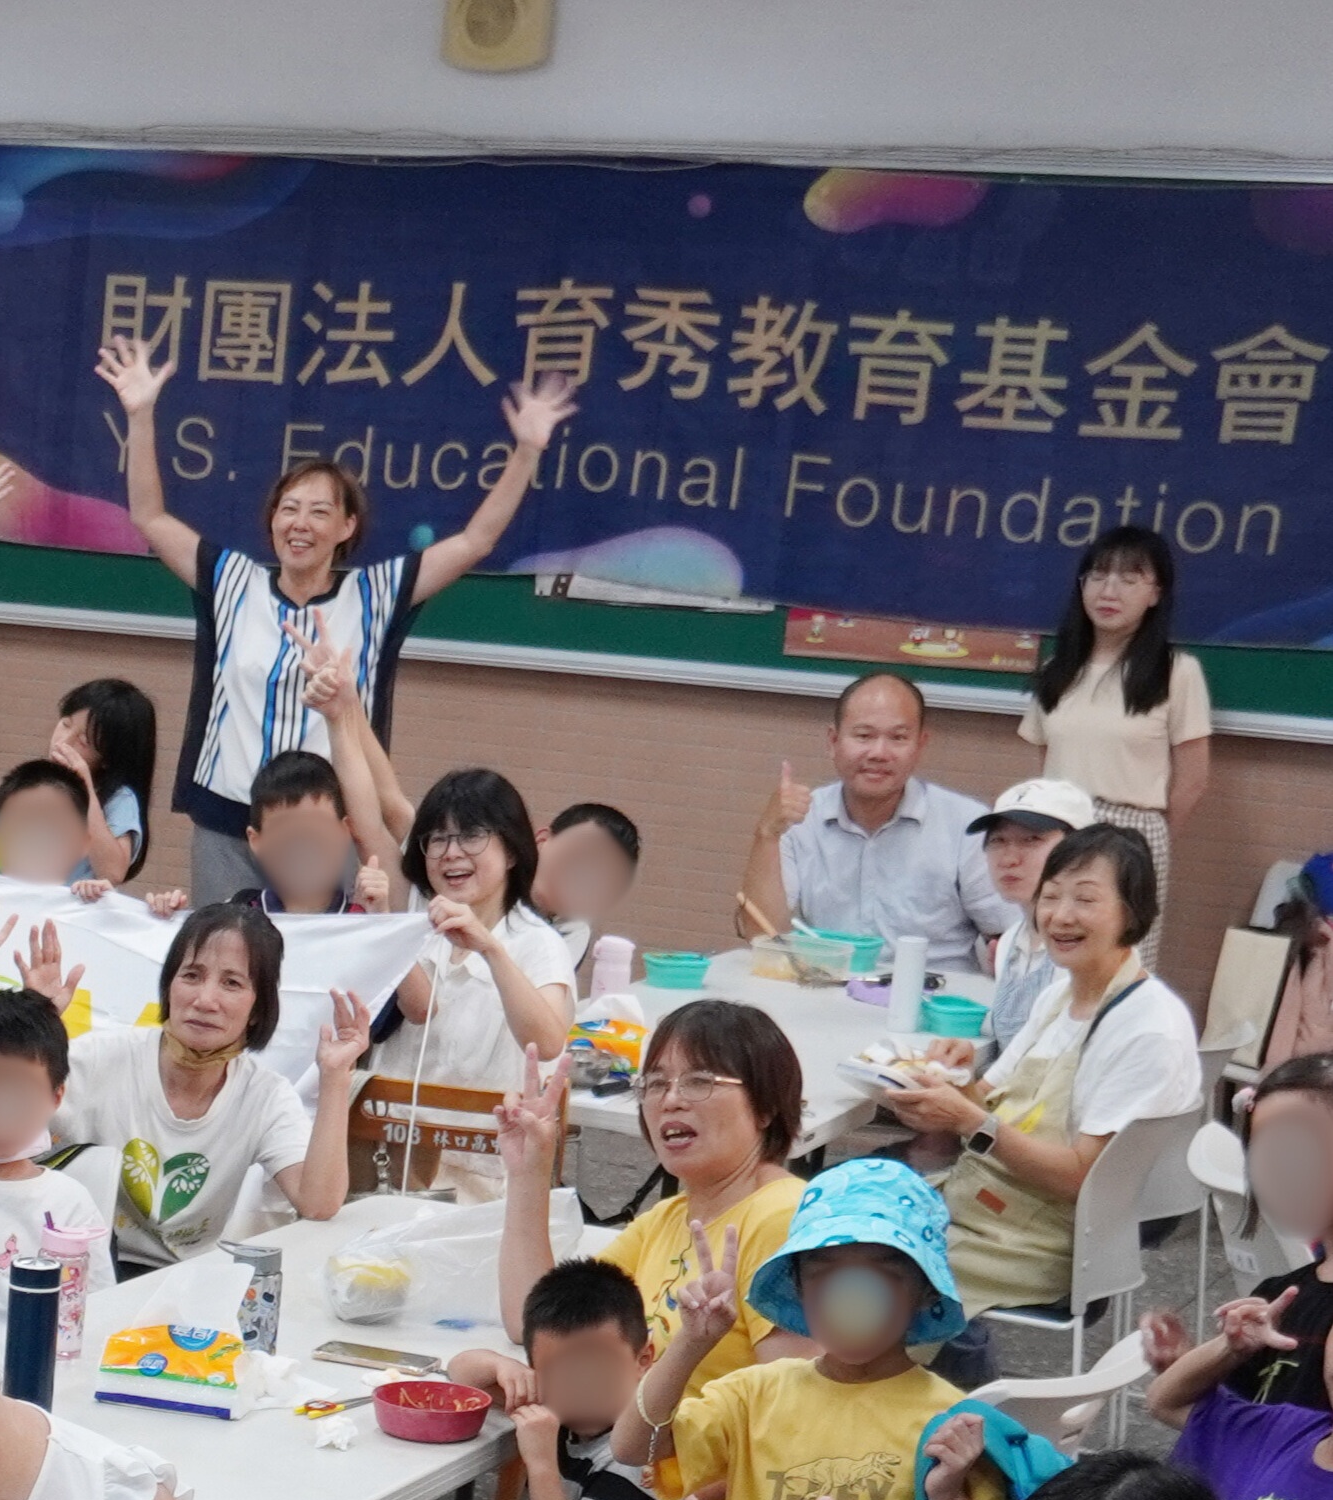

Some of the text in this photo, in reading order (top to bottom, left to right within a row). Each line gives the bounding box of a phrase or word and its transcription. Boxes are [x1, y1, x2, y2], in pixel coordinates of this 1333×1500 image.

[98, 272, 1328, 449] 財團法人育秀教育基金會
[280, 421, 744, 512] Educaional
